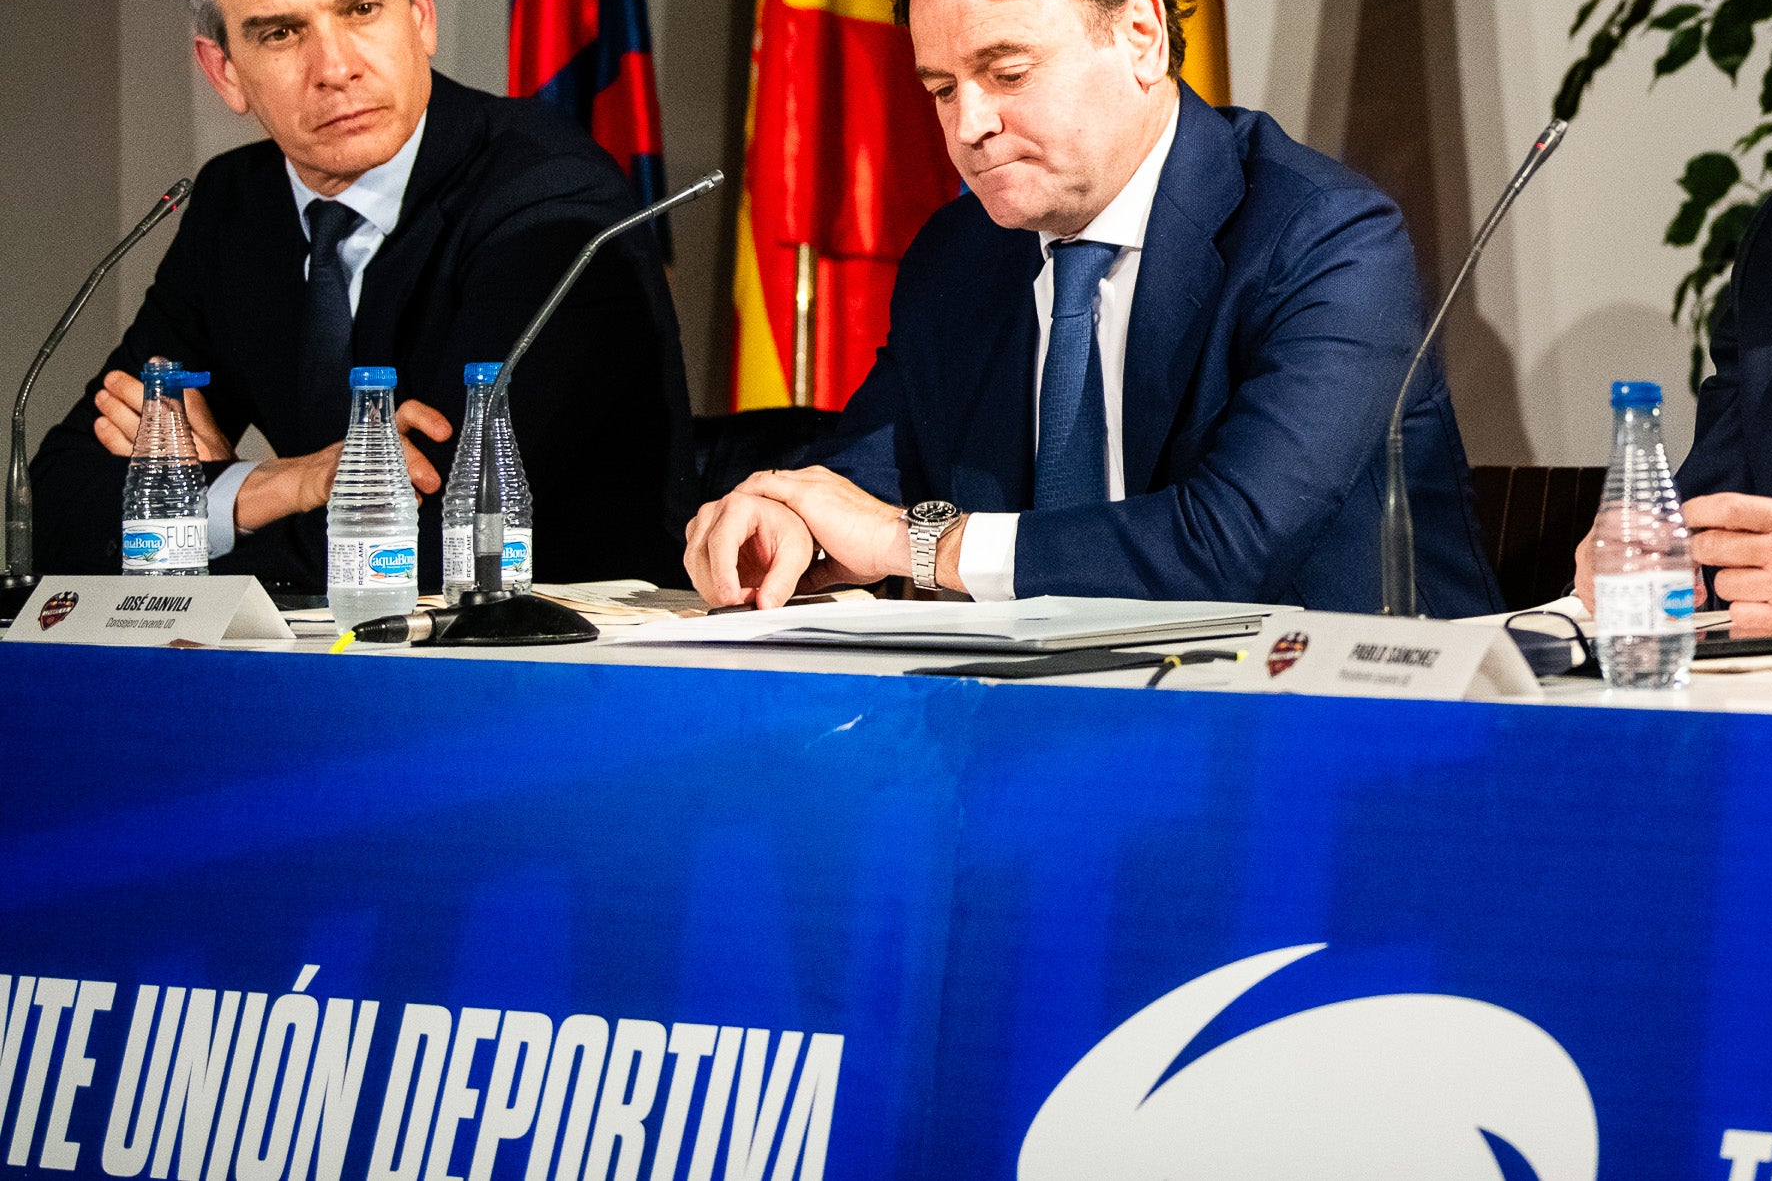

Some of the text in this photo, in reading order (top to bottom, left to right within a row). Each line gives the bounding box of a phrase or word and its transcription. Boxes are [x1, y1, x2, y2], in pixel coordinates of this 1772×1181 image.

[116, 593, 193, 612] JOSÉ DANVILA
[138, 618, 165, 629] Levante
[101, 964, 380, 1181] UNIÓN
[367, 1003, 845, 1181] DEPORTIVA
